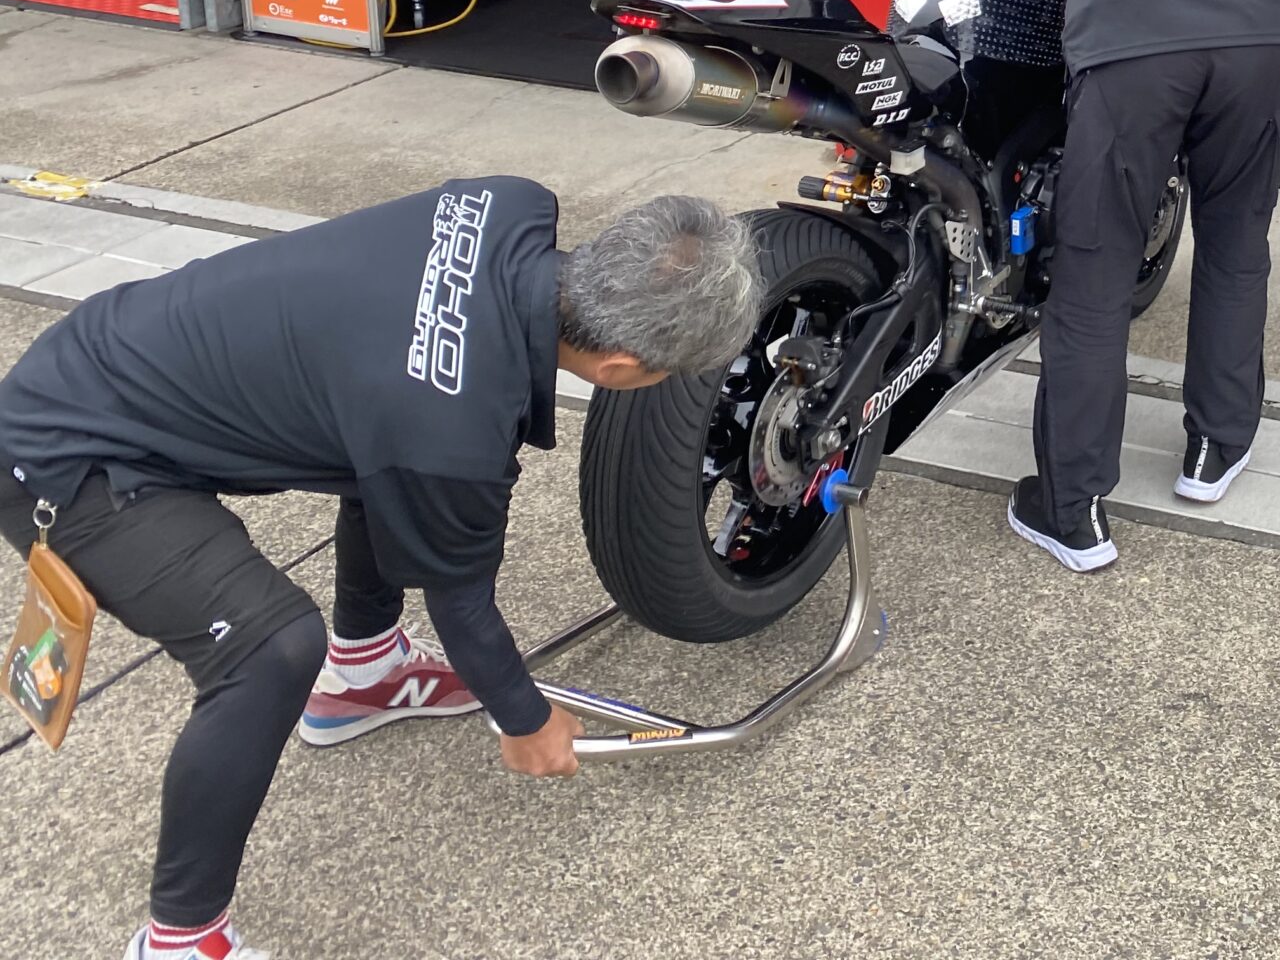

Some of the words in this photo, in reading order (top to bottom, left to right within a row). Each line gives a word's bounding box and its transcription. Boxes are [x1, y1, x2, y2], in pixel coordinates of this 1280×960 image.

[701, 83, 741, 99] MORIWAKI
[858, 79, 893, 92] MOTUL
[407, 231, 452, 381] Racing
[431, 190, 492, 395] TOHO
[862, 335, 942, 423] BRIDGES
[387, 678, 440, 708] N
